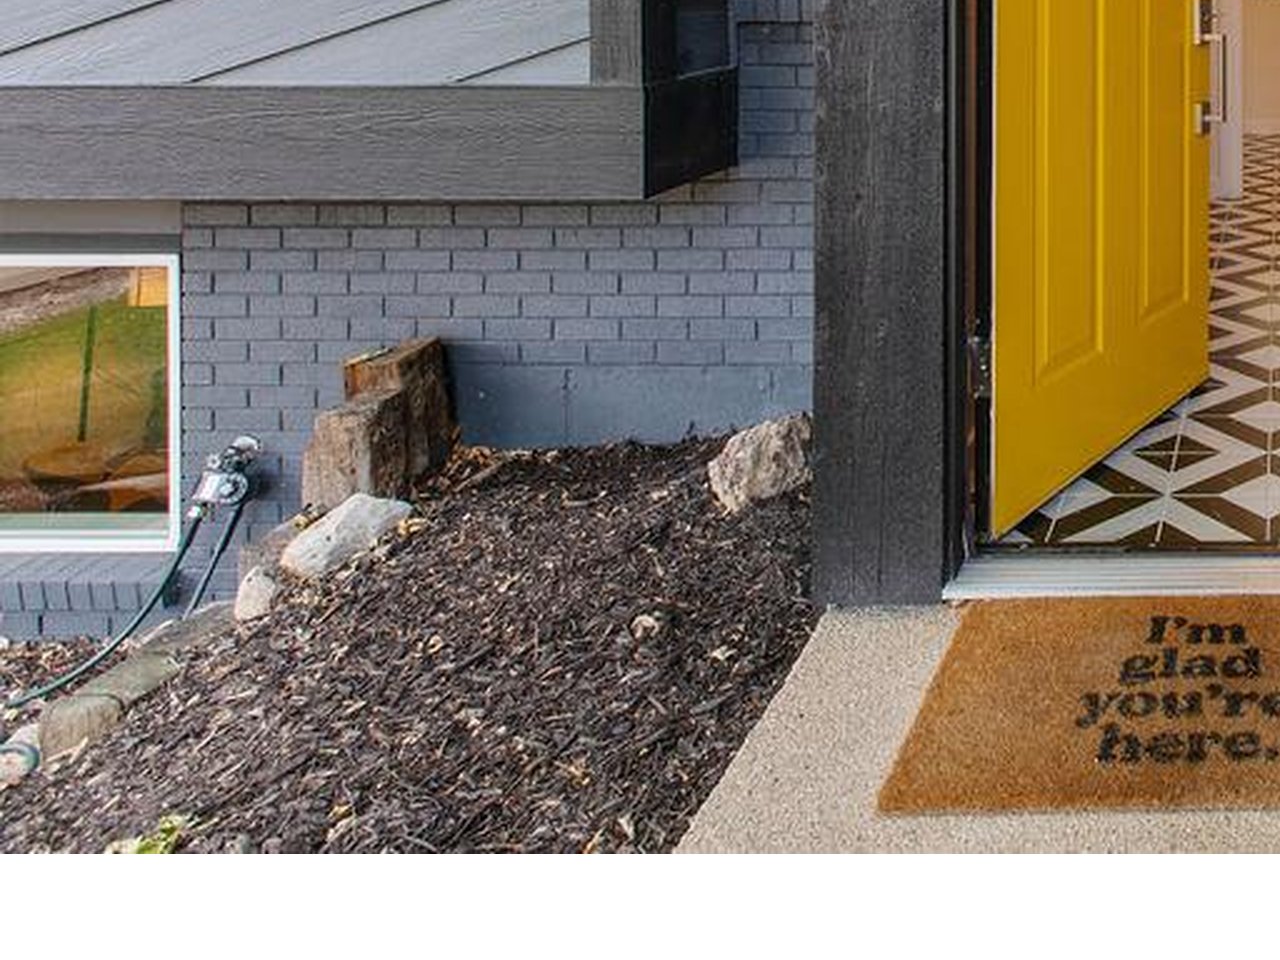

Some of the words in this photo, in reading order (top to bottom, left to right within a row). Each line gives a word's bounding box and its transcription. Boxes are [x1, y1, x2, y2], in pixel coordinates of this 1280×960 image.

[1145, 614, 1247, 645] I'm
[1119, 646, 1262, 684] glad
[1096, 725, 1280, 764] here.
